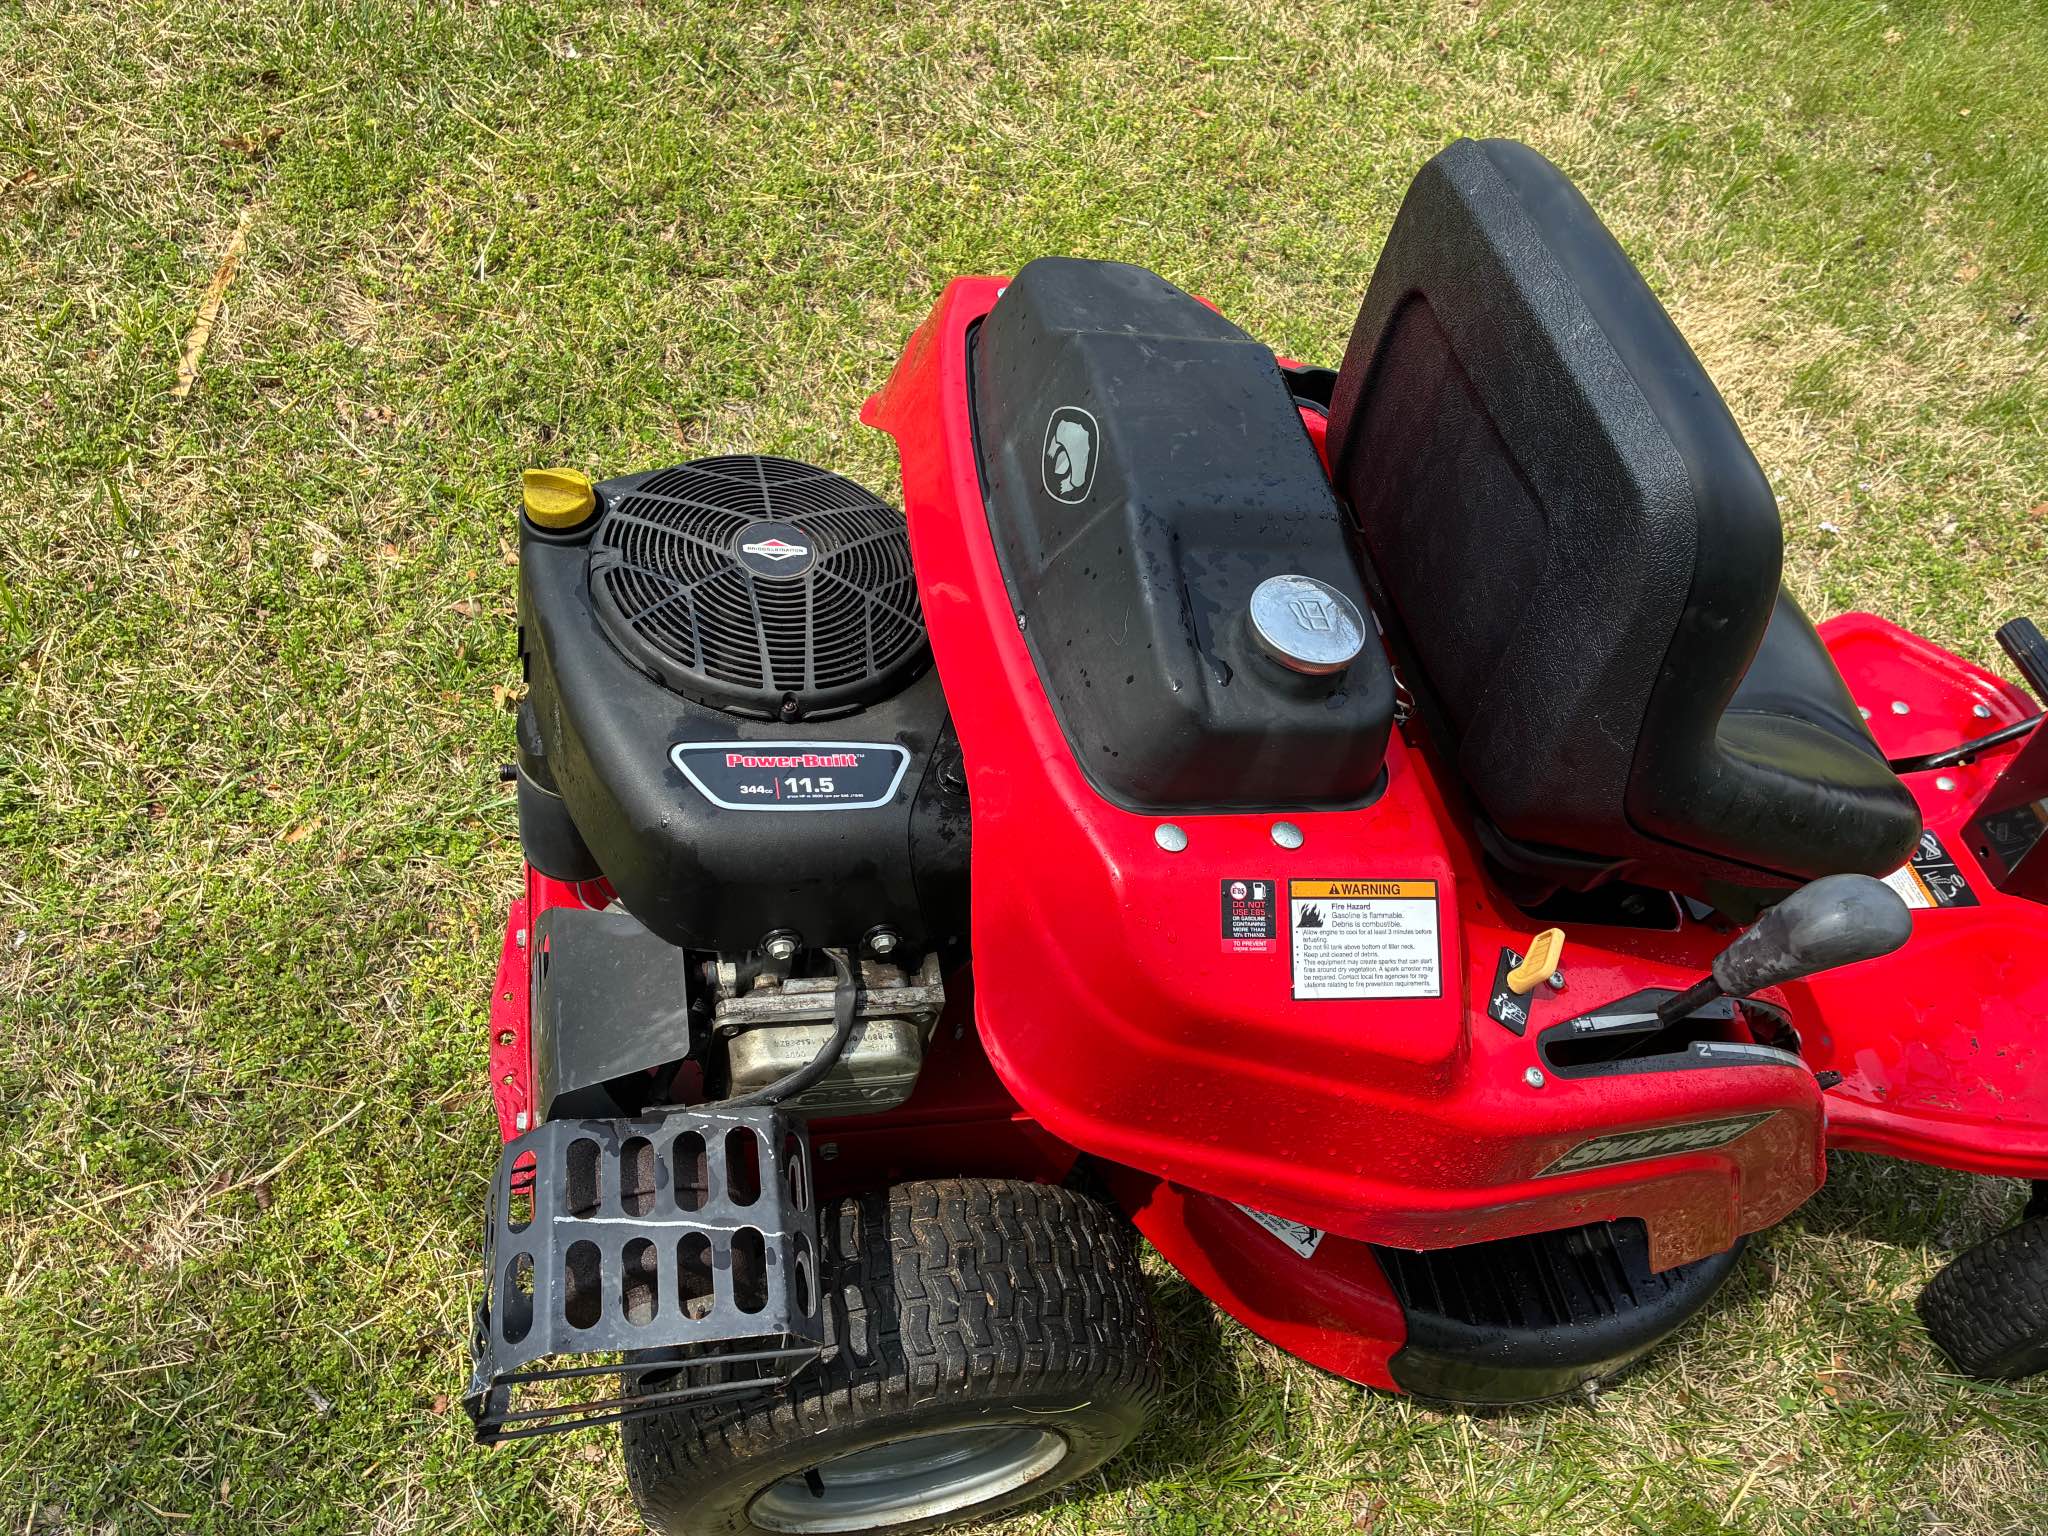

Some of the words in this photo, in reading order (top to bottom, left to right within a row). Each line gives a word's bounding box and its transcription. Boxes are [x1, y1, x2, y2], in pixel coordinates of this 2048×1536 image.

[784, 777, 834, 793] 11.5
[1342, 884, 1401, 895] WARNING
[1332, 920, 1354, 928] Debris
[1362, 920, 1402, 928] combustible.
[1560, 1122, 1750, 1168] SNAPPER
